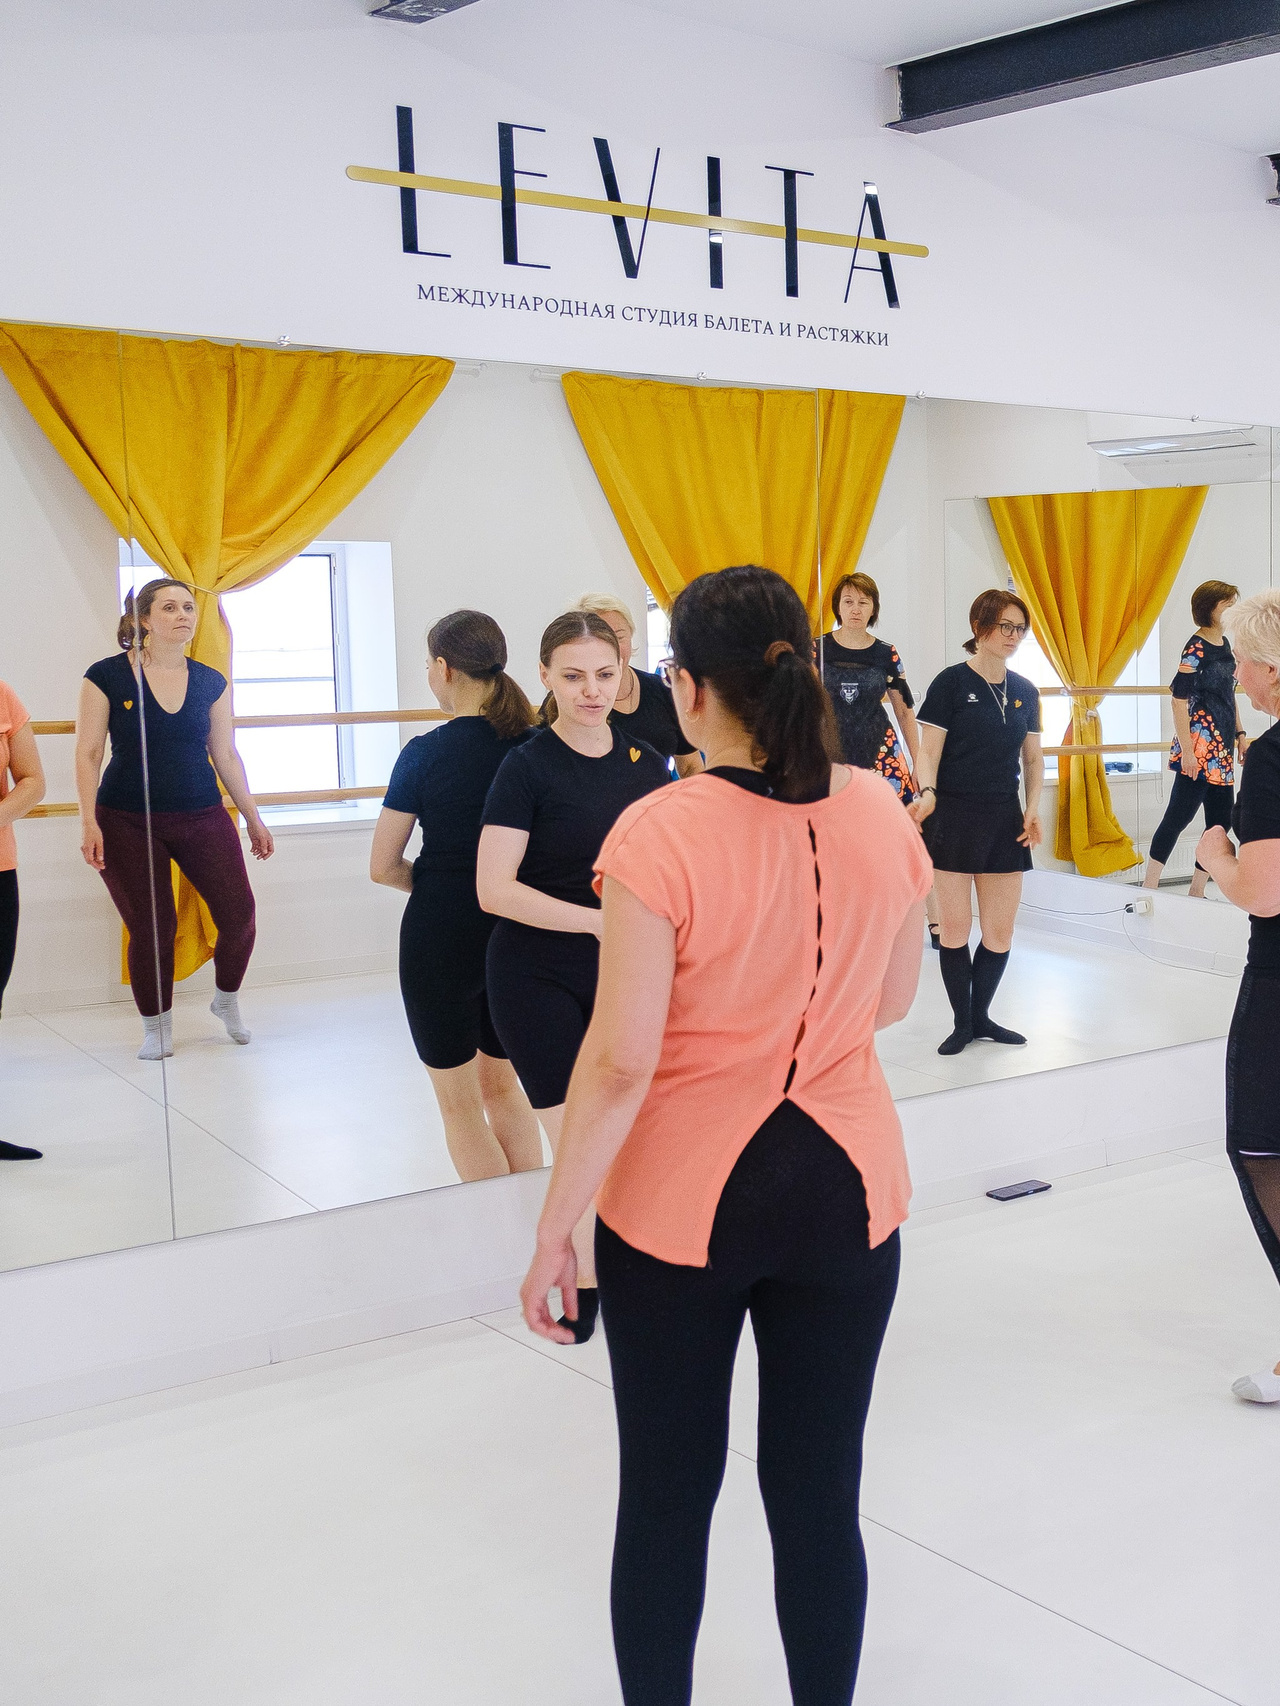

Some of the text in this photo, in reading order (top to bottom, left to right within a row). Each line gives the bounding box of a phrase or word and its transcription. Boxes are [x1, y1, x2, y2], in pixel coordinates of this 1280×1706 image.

[397, 105, 900, 309] LEVITA
[417, 283, 889, 347] МЕЖДУНАРОДНАЯ СТУДИЯ БАЛЕТА И РАСТЯЖКИ
